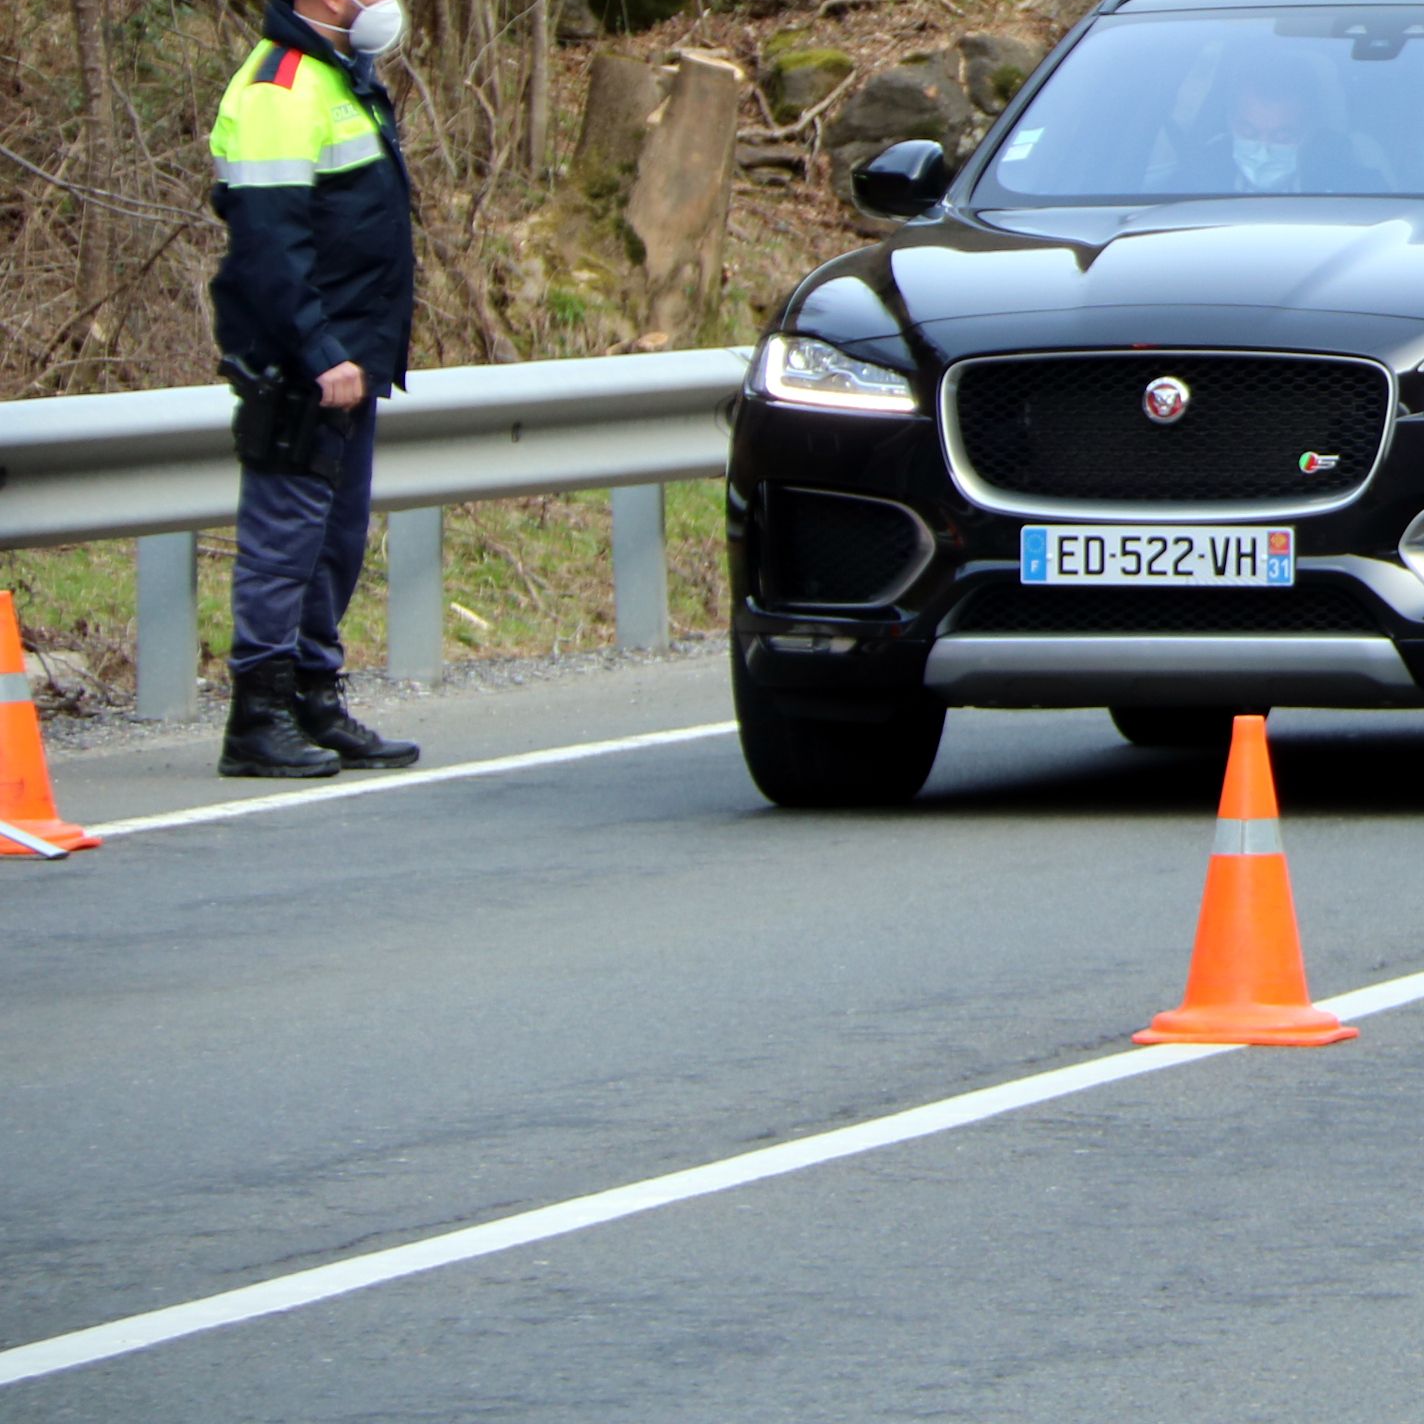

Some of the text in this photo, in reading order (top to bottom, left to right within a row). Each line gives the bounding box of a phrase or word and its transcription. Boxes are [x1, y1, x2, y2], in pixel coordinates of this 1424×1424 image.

[1030, 559, 1040, 574] F
[1057, 535, 1257, 577] ED-522-VH
[1267, 557, 1290, 579] 31
